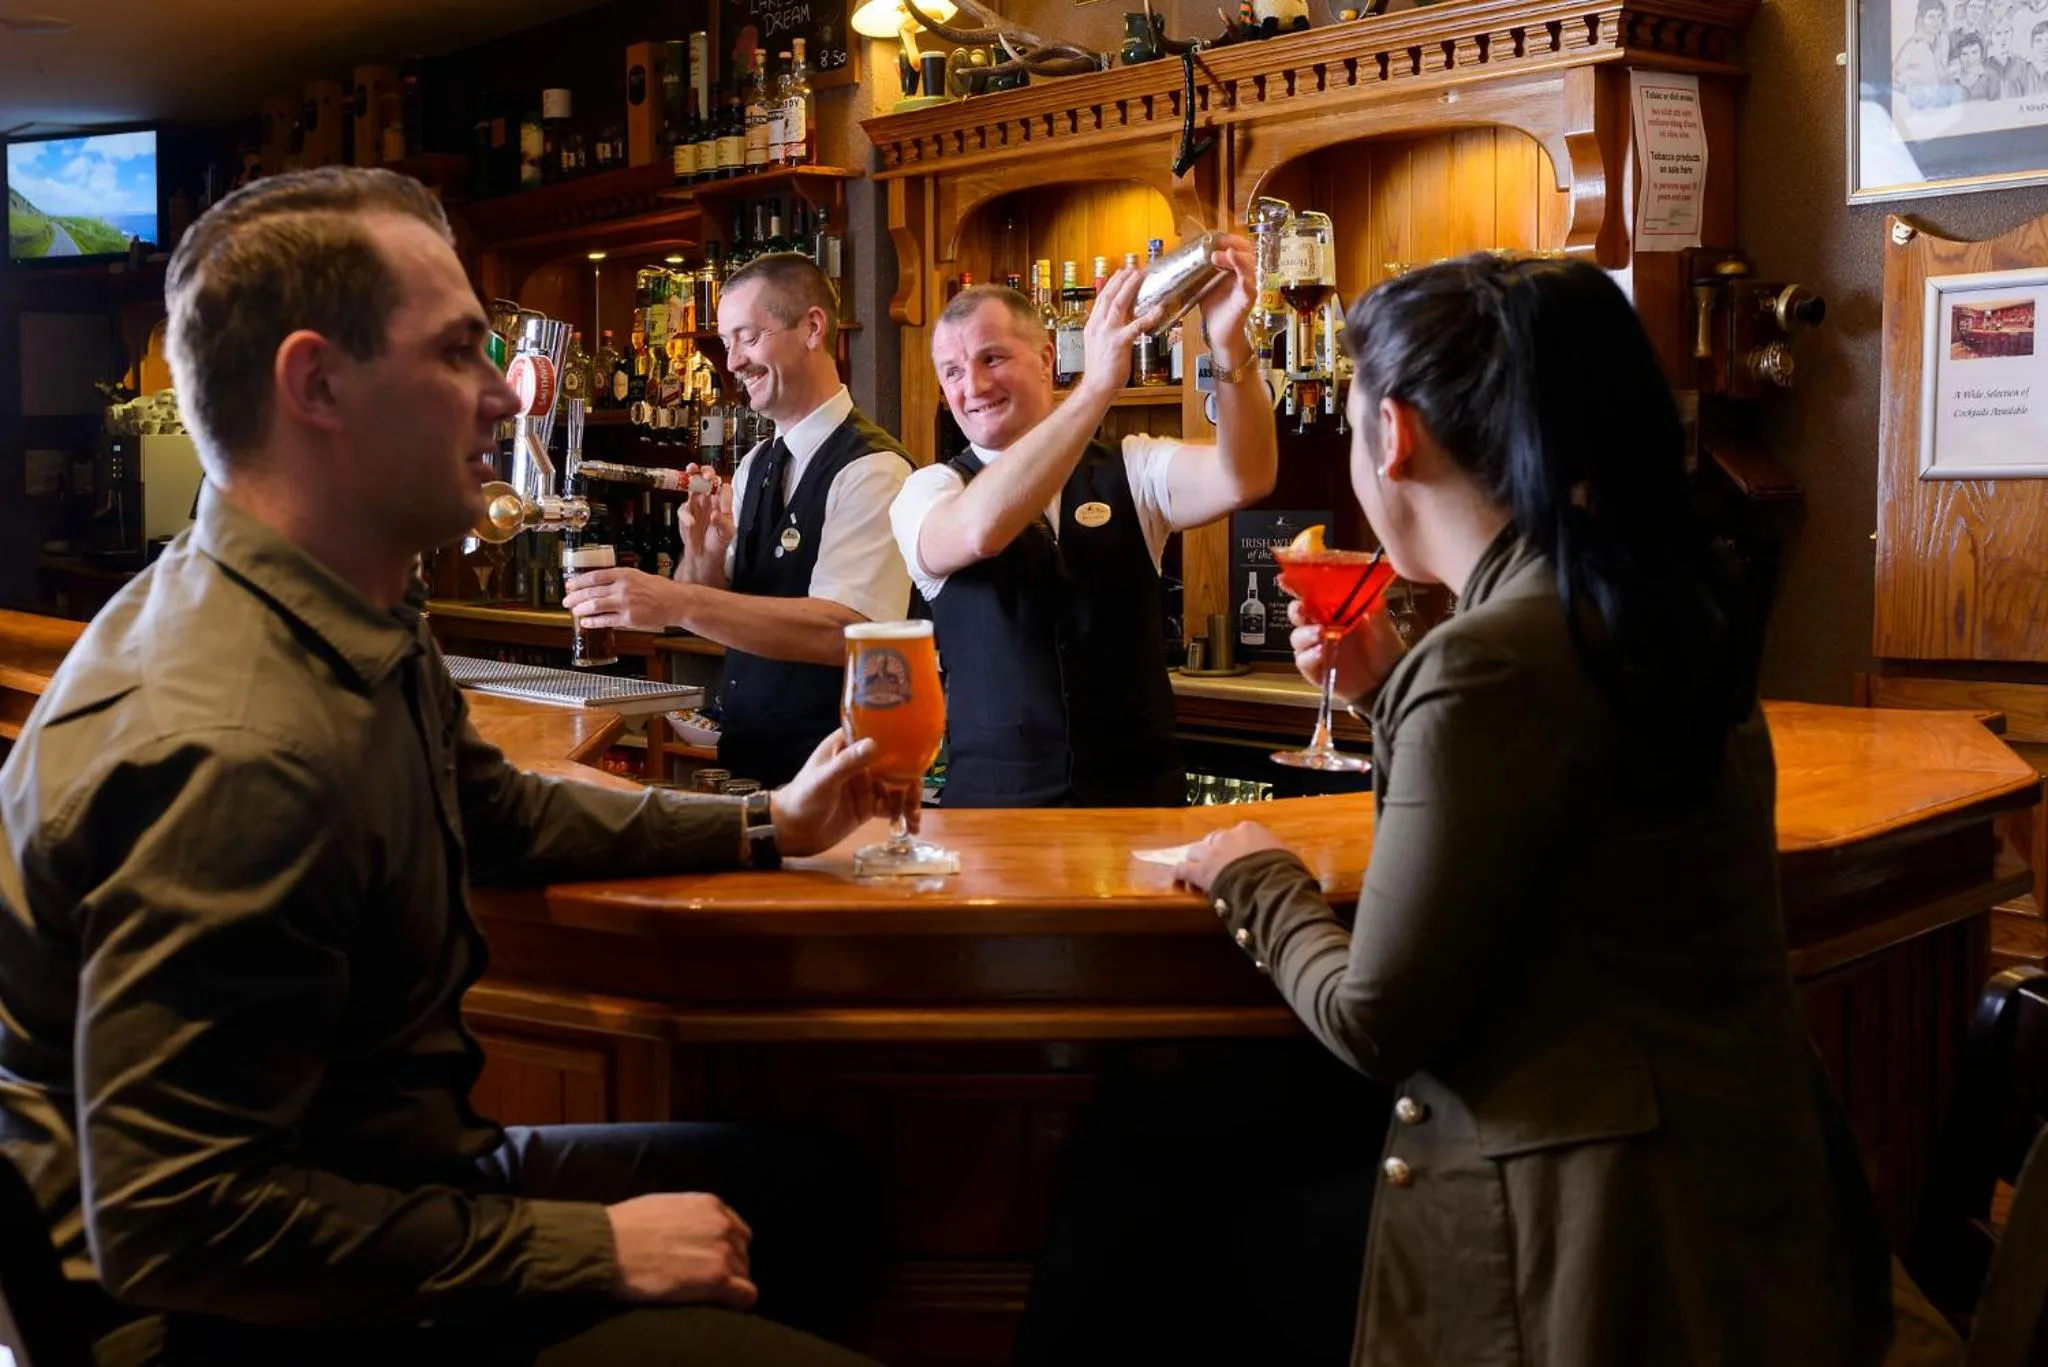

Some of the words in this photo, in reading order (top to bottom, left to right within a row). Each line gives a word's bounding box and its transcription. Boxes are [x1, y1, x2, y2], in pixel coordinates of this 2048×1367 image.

[763, 3, 810, 37] DREAM
[1650, 151, 1675, 161] Tobacco
[1241, 538, 1271, 548] IRISH
[1247, 549, 1257, 563] of
